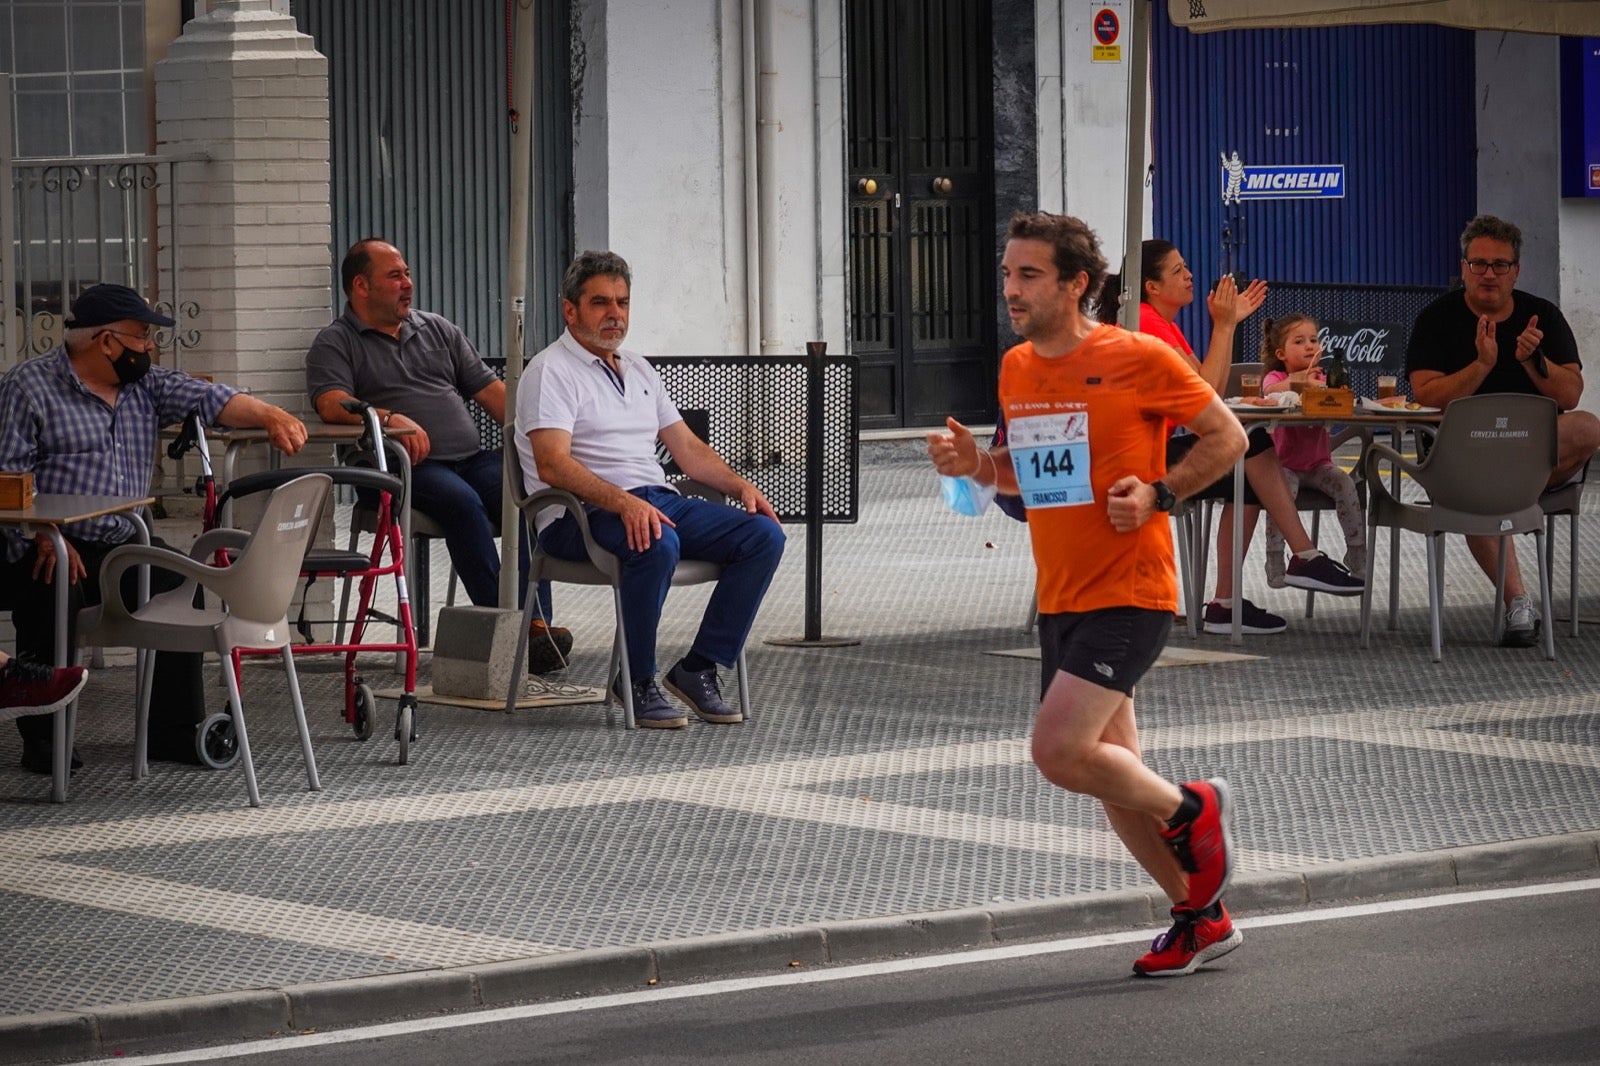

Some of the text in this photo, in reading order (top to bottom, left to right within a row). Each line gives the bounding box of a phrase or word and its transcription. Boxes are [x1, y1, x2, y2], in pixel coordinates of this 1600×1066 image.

[1247, 172, 1340, 189] MICHELIN
[1030, 448, 1075, 479] 144
[1032, 490, 1068, 505] FRANCISCO
